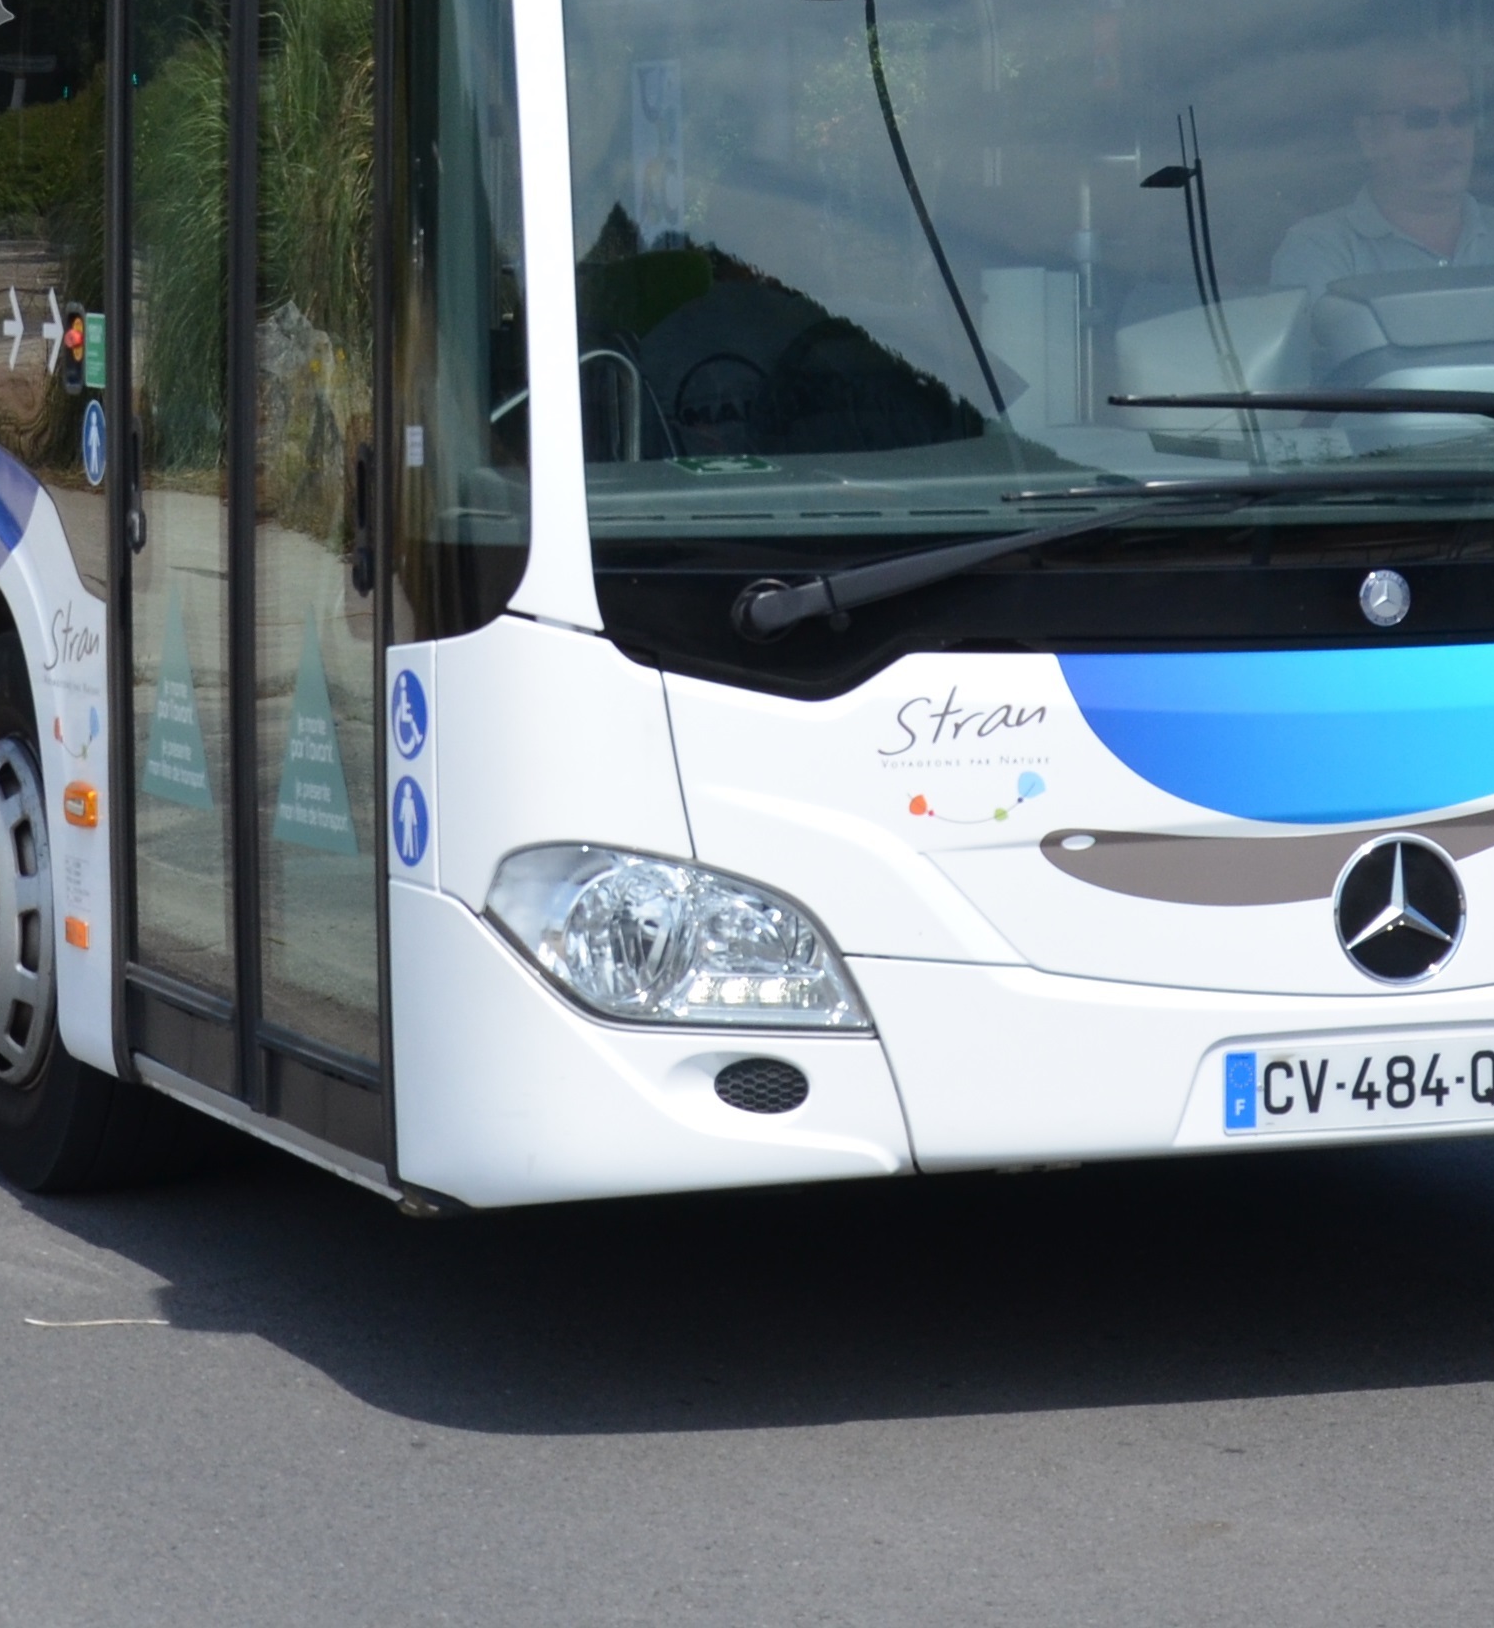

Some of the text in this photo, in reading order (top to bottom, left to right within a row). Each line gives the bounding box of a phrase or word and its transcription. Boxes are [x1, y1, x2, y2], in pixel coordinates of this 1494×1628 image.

[43, 600, 99, 671] Stran
[878, 685, 1047, 756] Stran
[1235, 1098, 1246, 1116] F
